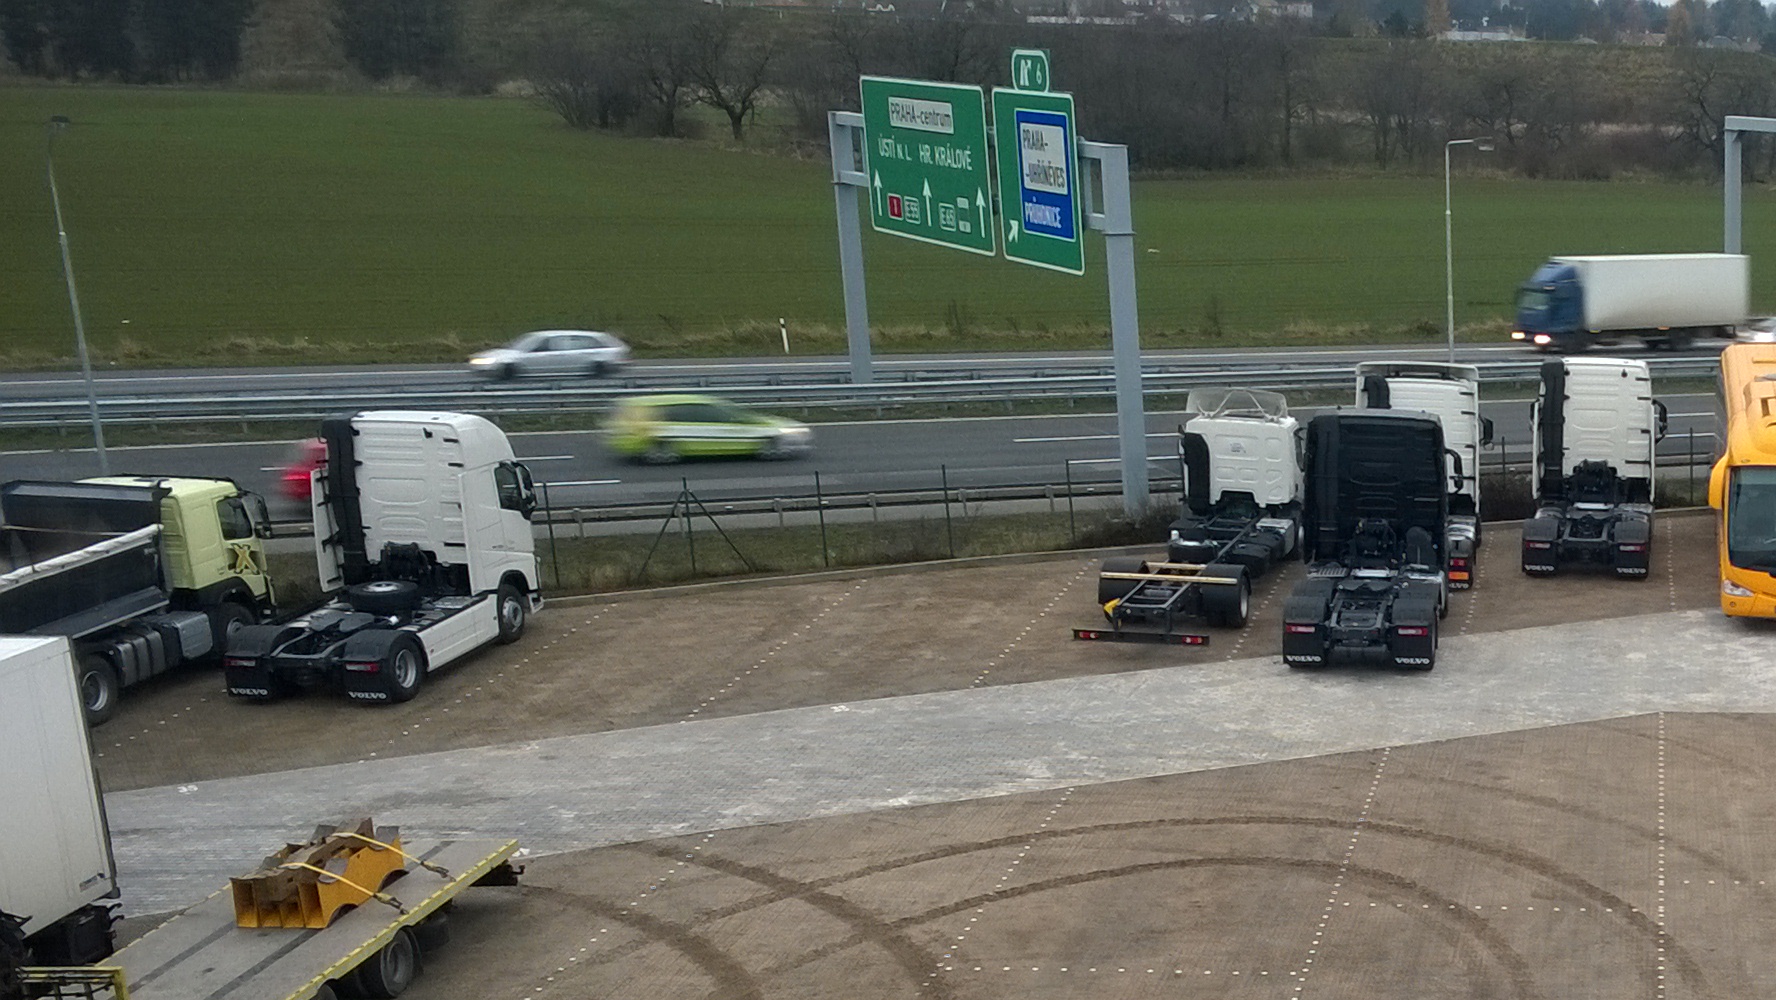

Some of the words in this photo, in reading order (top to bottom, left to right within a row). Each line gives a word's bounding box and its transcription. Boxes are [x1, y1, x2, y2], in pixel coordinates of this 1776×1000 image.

[1036, 62, 1042, 85] 6
[890, 102, 952, 127] PRAHA-centrum
[934, 142, 973, 171] KRÁLOVÉ
[230, 688, 268, 696] VOLVO
[348, 691, 387, 699] VOLVO
